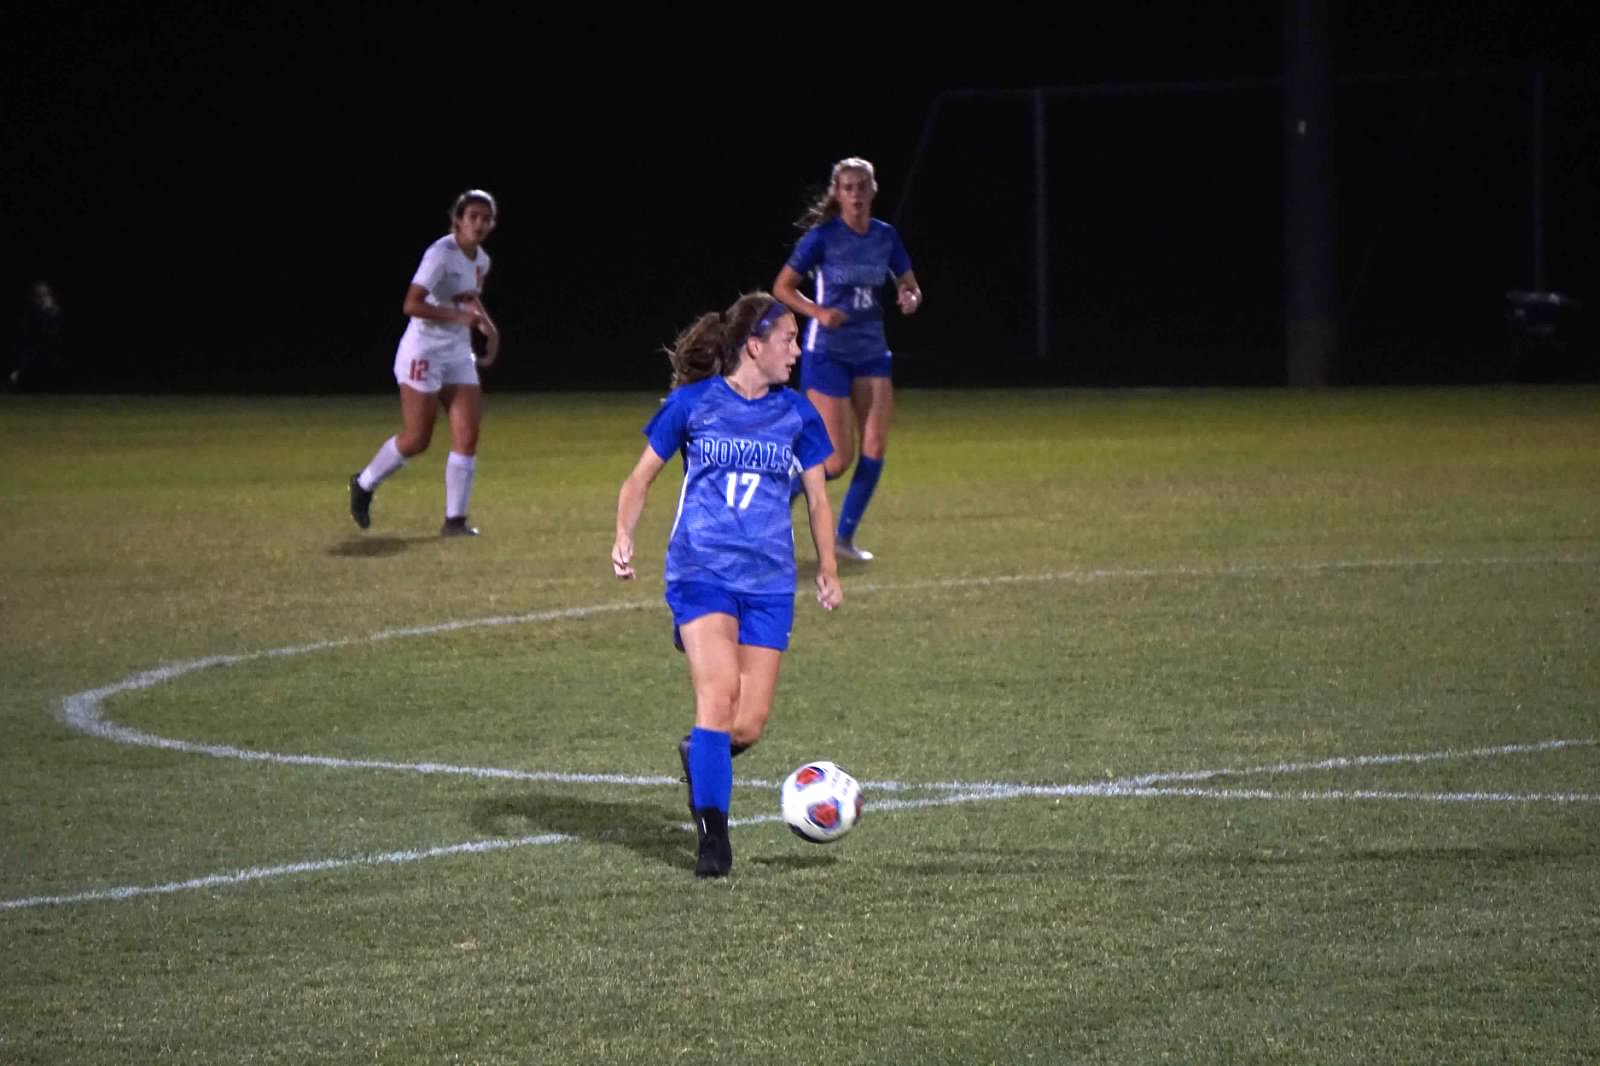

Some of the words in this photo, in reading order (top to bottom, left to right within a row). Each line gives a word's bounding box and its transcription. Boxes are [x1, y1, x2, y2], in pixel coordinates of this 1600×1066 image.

[409, 359, 429, 382] 12
[700, 437, 792, 473] ROYALS
[726, 471, 760, 510] 17
